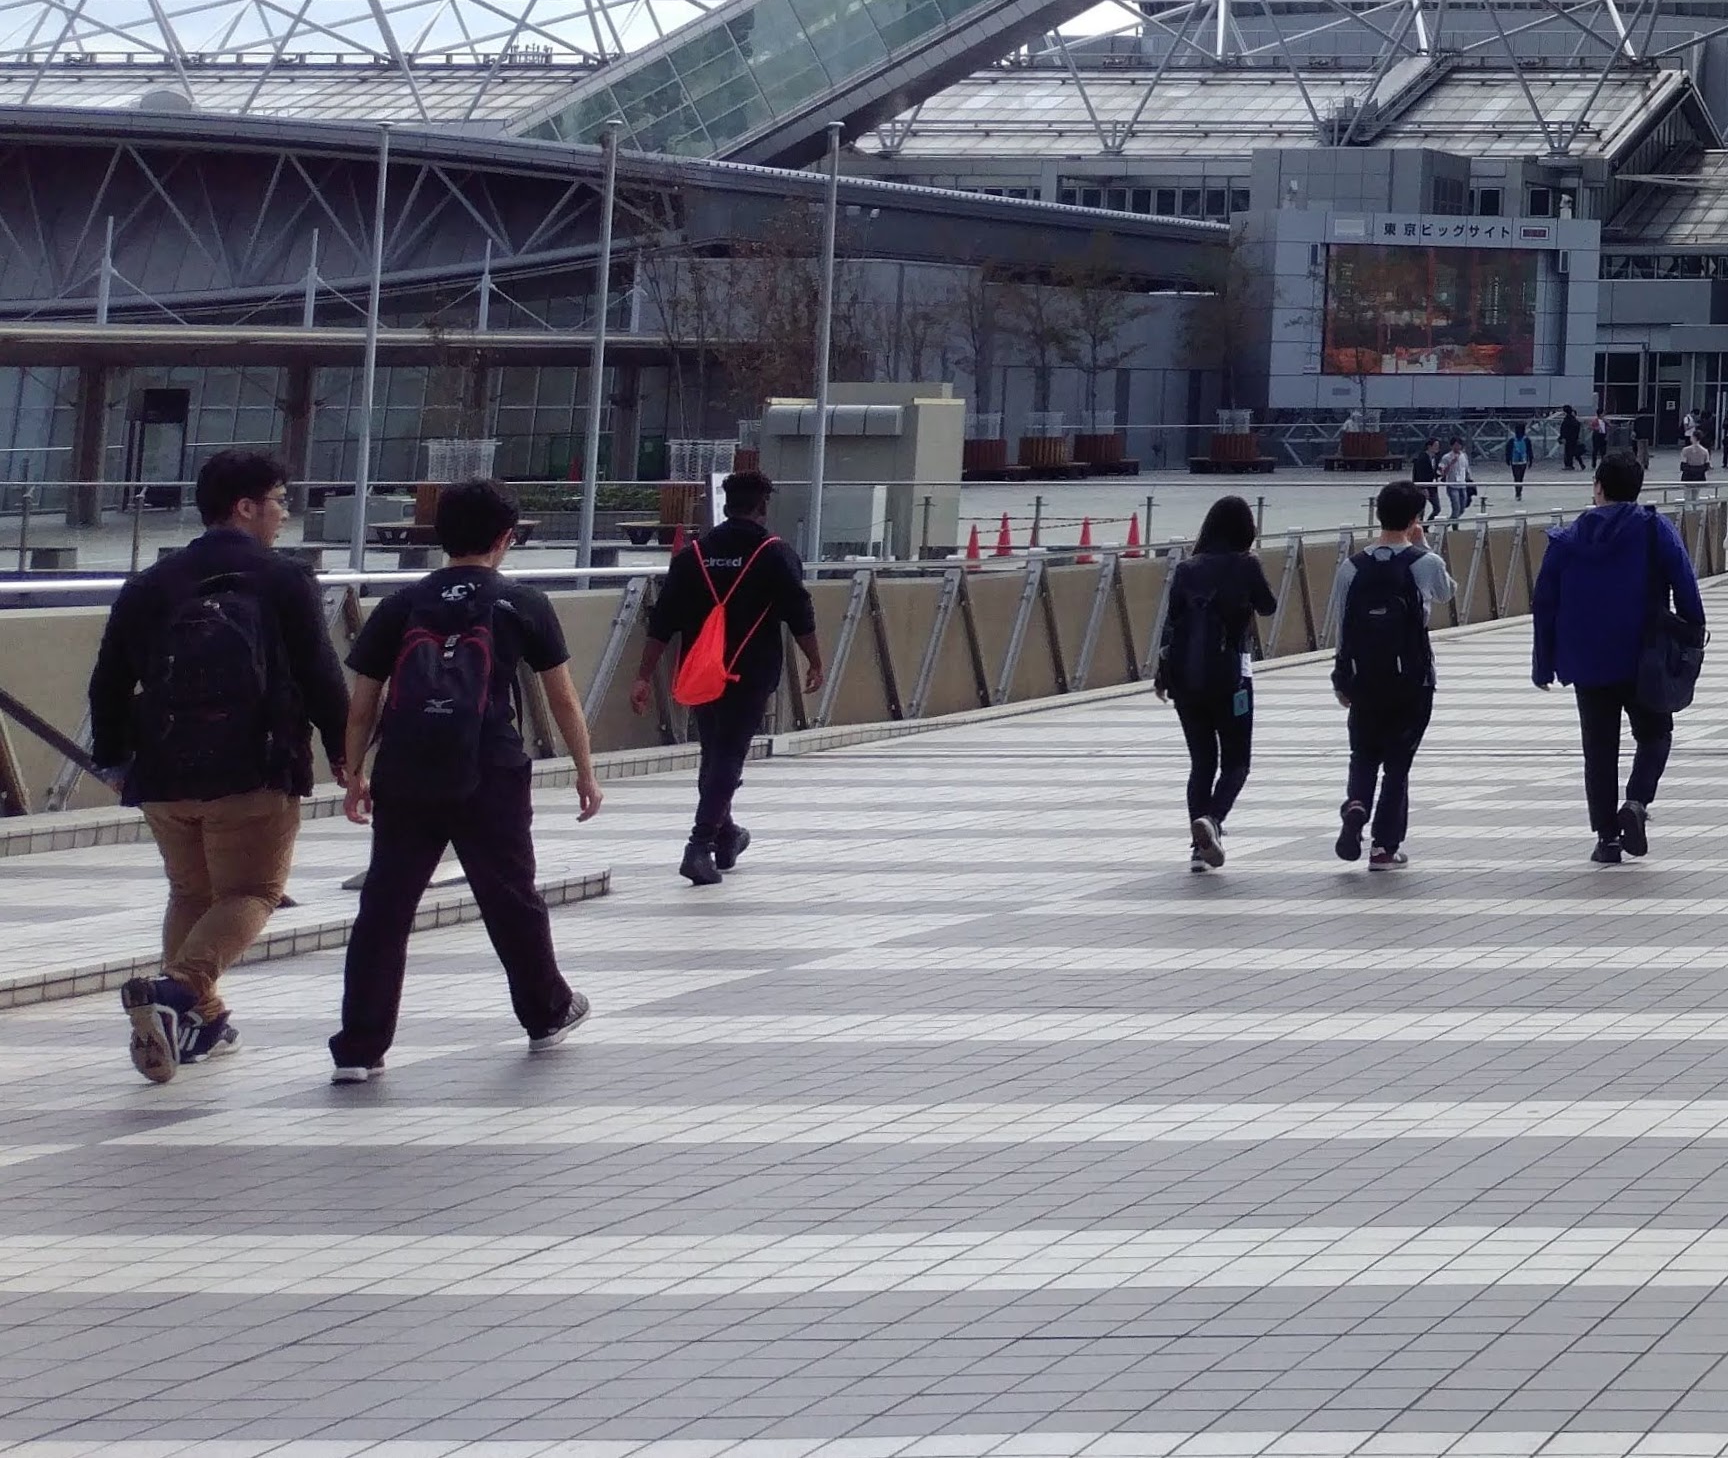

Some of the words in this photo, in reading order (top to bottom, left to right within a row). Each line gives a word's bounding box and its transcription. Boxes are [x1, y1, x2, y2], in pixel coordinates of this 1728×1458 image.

[1384, 222, 1510, 238] 東京ビッグサイト
